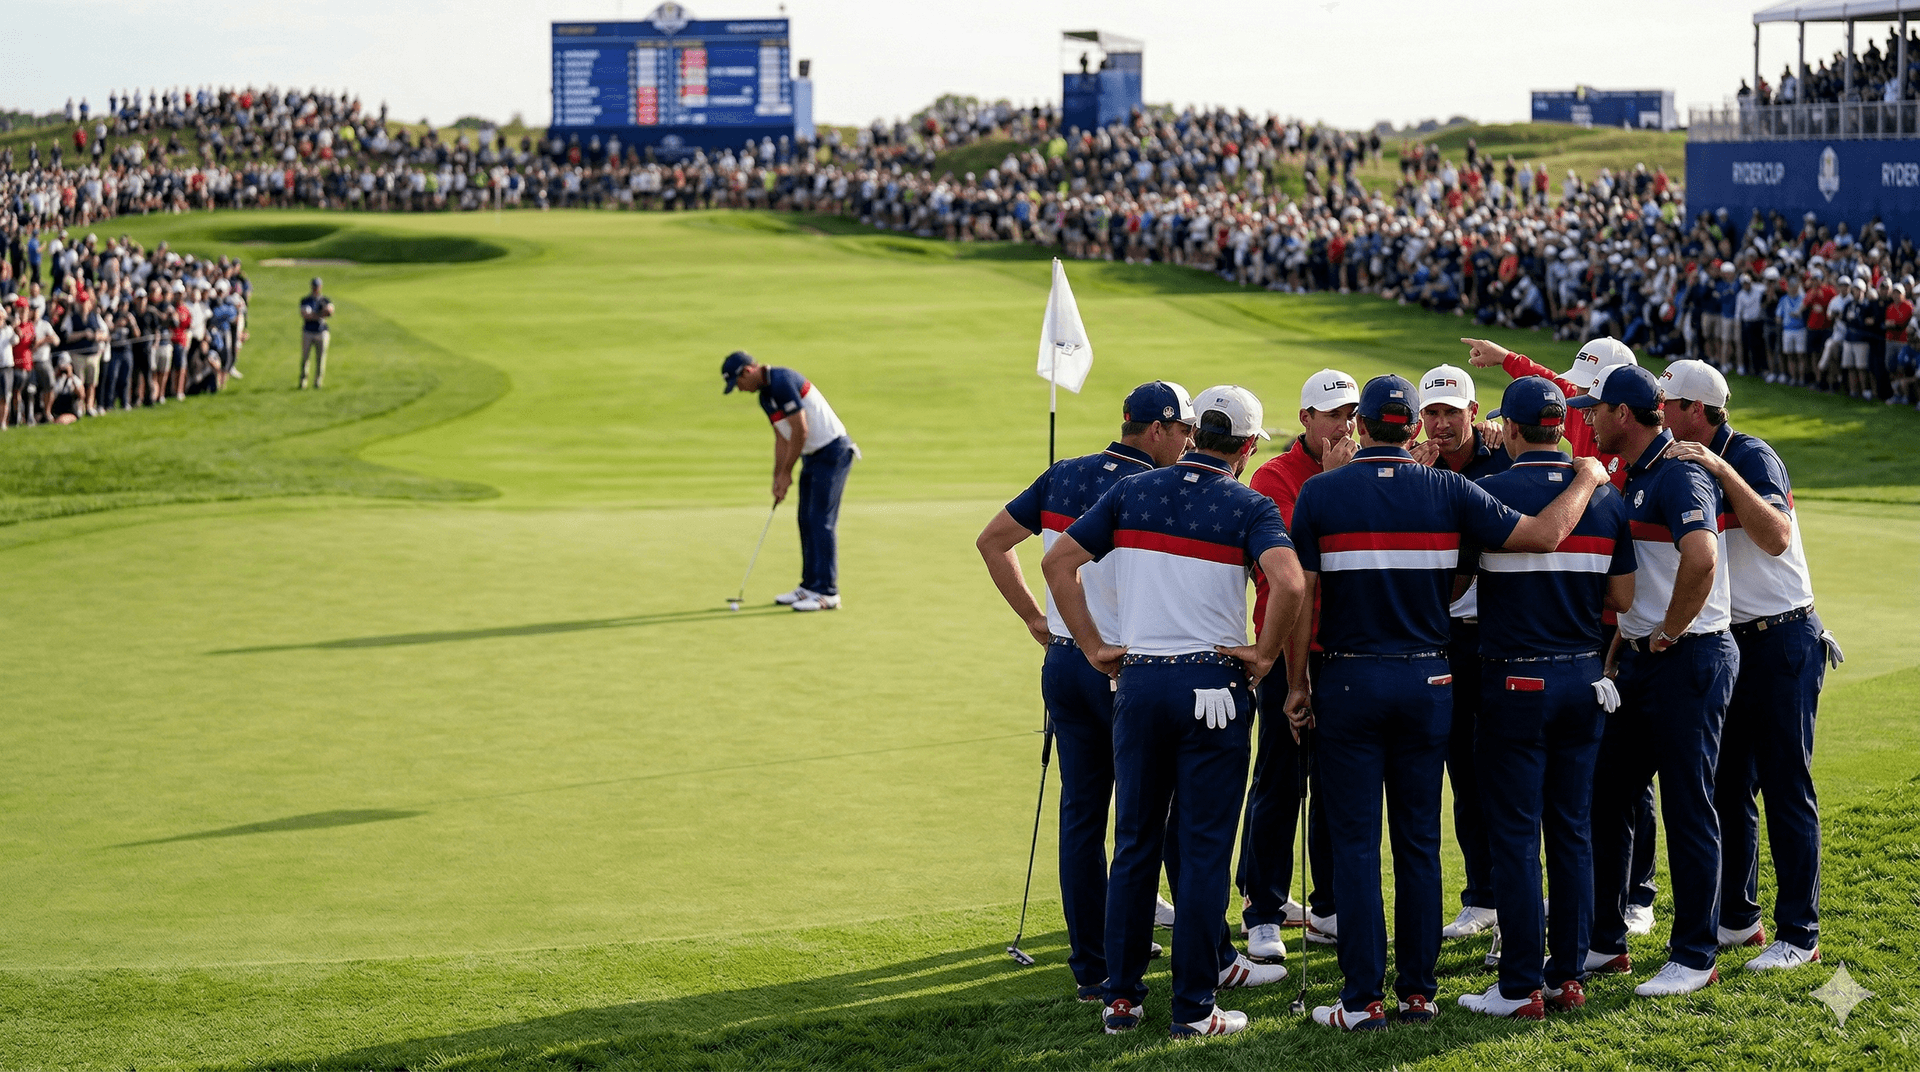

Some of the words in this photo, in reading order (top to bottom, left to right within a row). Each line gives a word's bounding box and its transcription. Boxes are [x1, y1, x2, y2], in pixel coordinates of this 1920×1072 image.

[1764, 162, 1785, 185] CUP
[1881, 162, 1919, 187] RYDER
[1323, 381, 1355, 391] USA
[1425, 379, 1457, 390] USA
